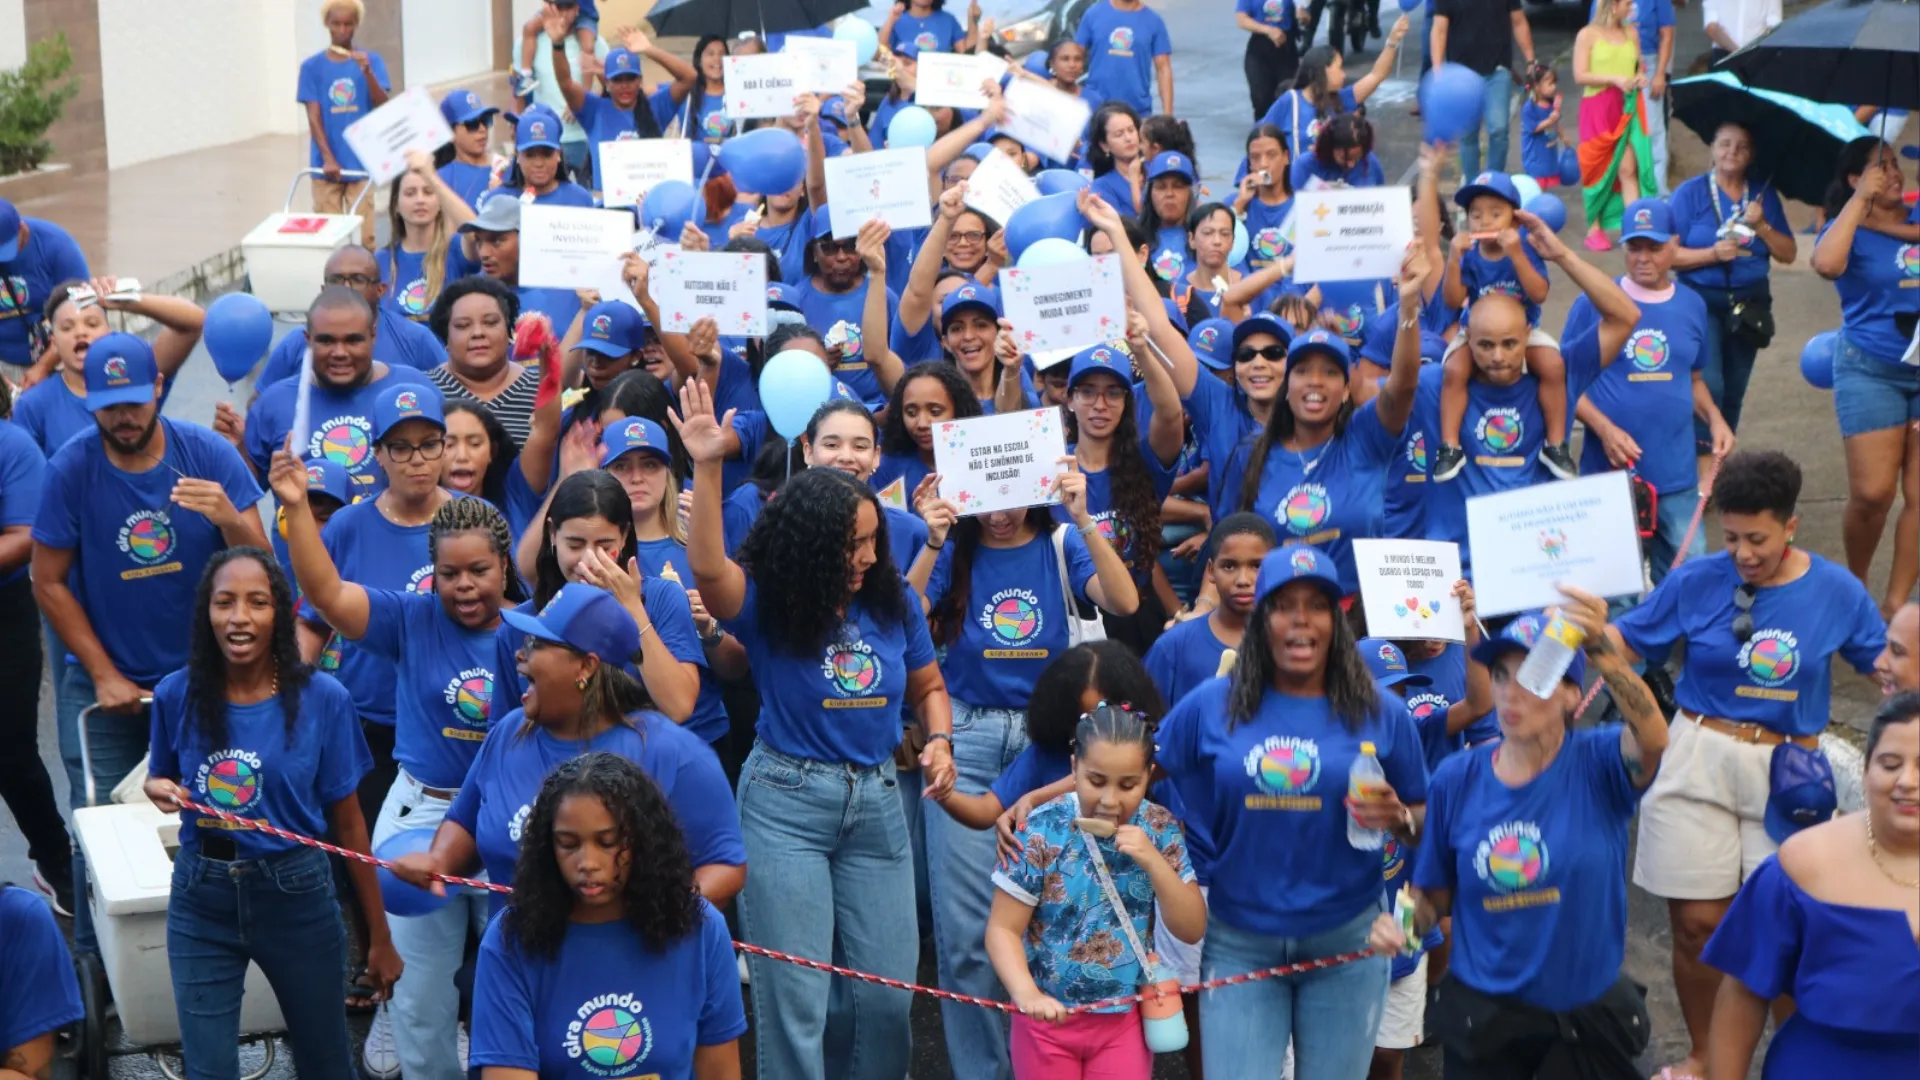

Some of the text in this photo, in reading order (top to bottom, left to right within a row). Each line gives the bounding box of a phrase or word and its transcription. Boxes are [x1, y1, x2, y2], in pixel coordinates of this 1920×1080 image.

[549, 220, 570, 231] NÃO
[684, 279, 738, 291] AUTISMO NÃO É
[1033, 287, 1093, 307] CONHECIMENTO
[1039, 303, 1090, 320] MUDA VIDAS!
[307, 415, 372, 458] Gira mundo
[970, 440, 1029, 457] ESTAR NA ESCOLA
[969, 453, 1034, 471] NÃO É SINÔNIMO DE
[985, 468, 1020, 482] INCLUSÃO!
[1384, 553, 1436, 565] O MUNDO É MELHOR
[1379, 565, 1443, 578] QUANDO HÁ ESPAÇO PARA
[1406, 579, 1425, 589] TODOS!
[979, 588, 1039, 630] Gira mundo
[1751, 628, 1798, 648] mundo
[443, 677, 462, 705] Gira
[1407, 692, 1450, 710] mundo
[195, 749, 262, 794] Gira mundo
[508, 804, 532, 842] Gira
[562, 992, 643, 1059] Gira mundo
[580, 1058, 608, 1077] Espaço
[609, 1062, 637, 1077] Lúdico
